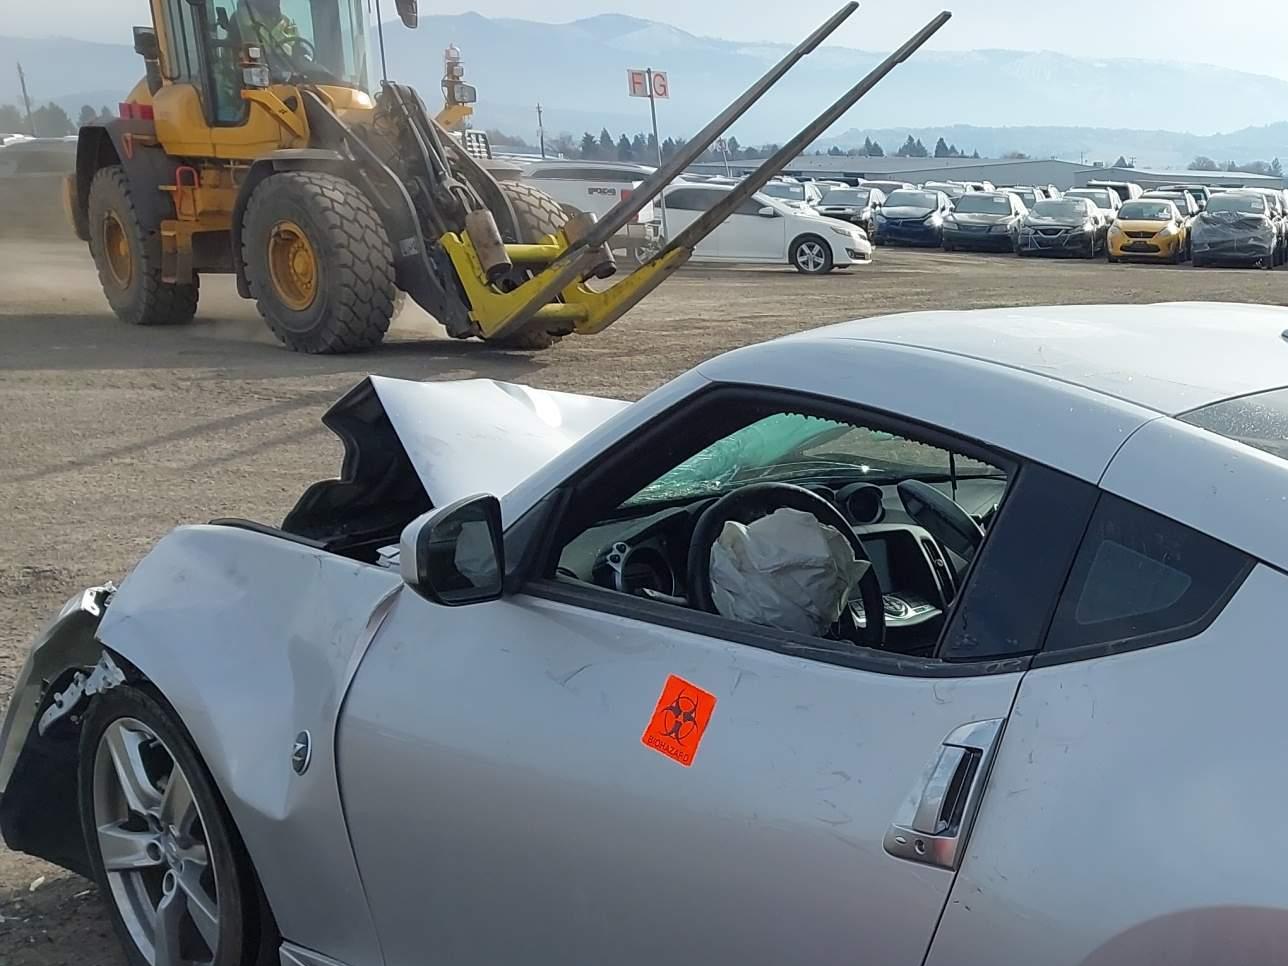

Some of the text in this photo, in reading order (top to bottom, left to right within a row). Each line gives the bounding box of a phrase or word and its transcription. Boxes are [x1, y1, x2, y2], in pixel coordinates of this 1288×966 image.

[631, 72, 667, 96] F G
[647, 735, 689, 762] BIOHAZARD
